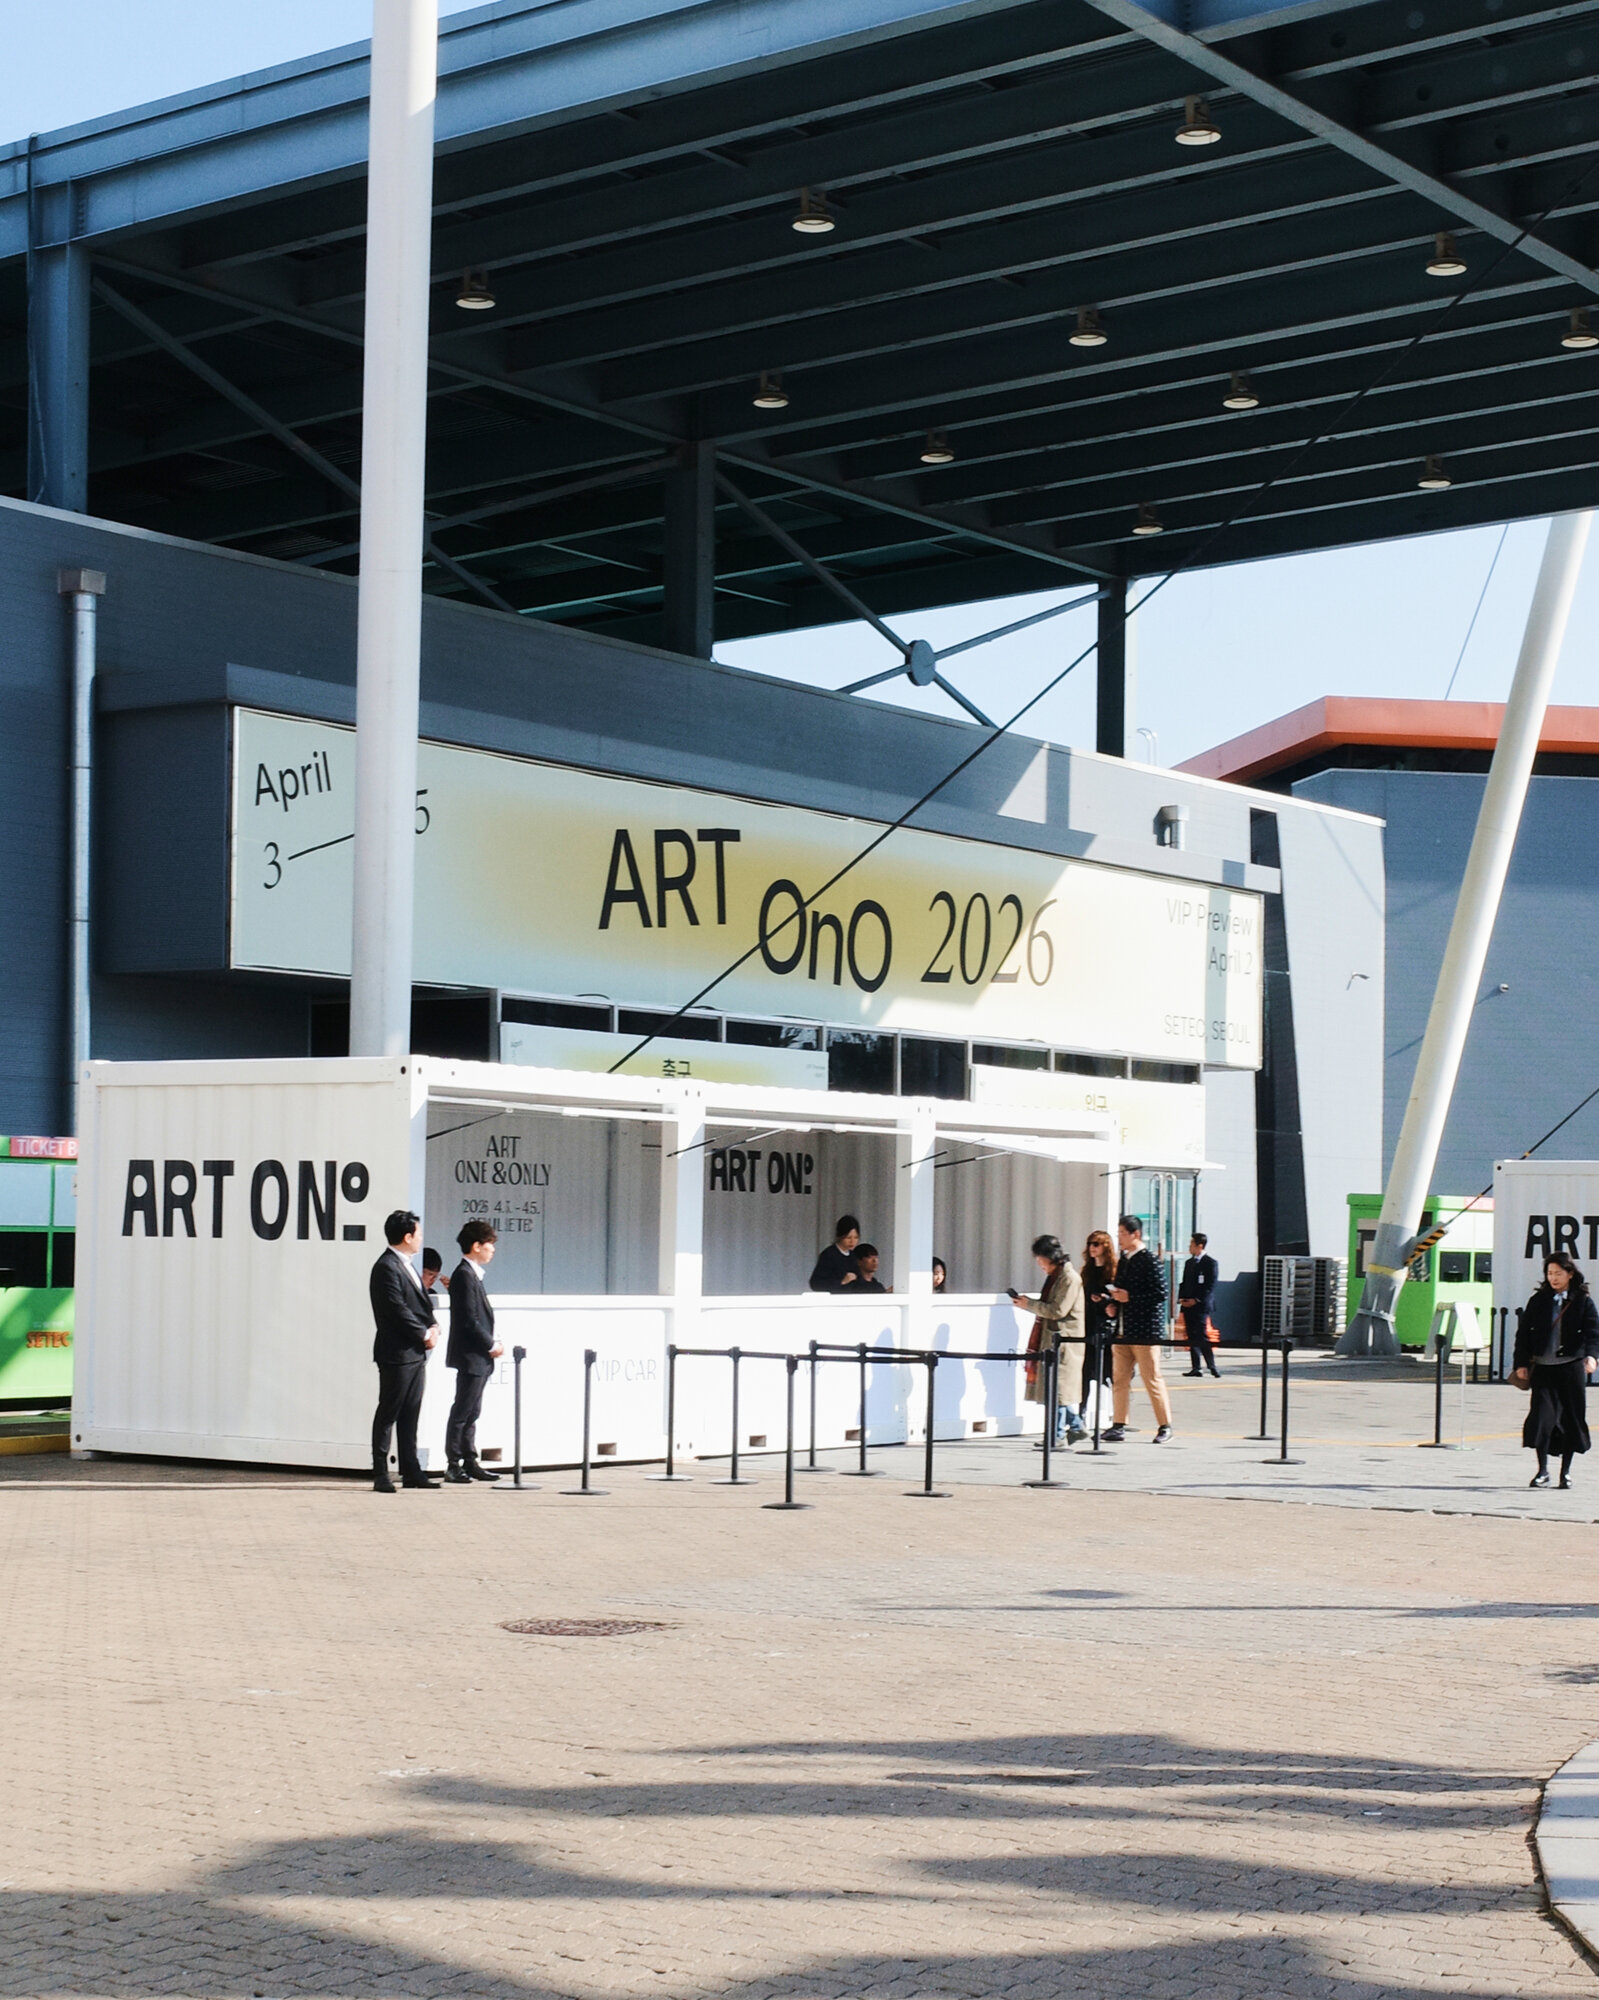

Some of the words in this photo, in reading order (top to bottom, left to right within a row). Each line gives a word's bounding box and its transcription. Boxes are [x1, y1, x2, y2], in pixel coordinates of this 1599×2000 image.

[254, 750, 332, 812] April
[598, 828, 741, 930] ART
[921, 890, 1059, 987] 2026
[1166, 898, 1192, 925] VIP
[1196, 902, 1253, 936] Preview
[1208, 946, 1241, 977] April
[1211, 1020, 1251, 1044] SEOUL
[17, 1138, 65, 1156] TICKET
[486, 1134, 521, 1159] ART
[709, 1147, 762, 1193] ART
[121, 1158, 235, 1239] ART
[1524, 1215, 1599, 1260] ART
[26, 1330, 70, 1349] SETEC
[594, 1359, 621, 1382] VIP
[624, 1359, 657, 1382] CAR
